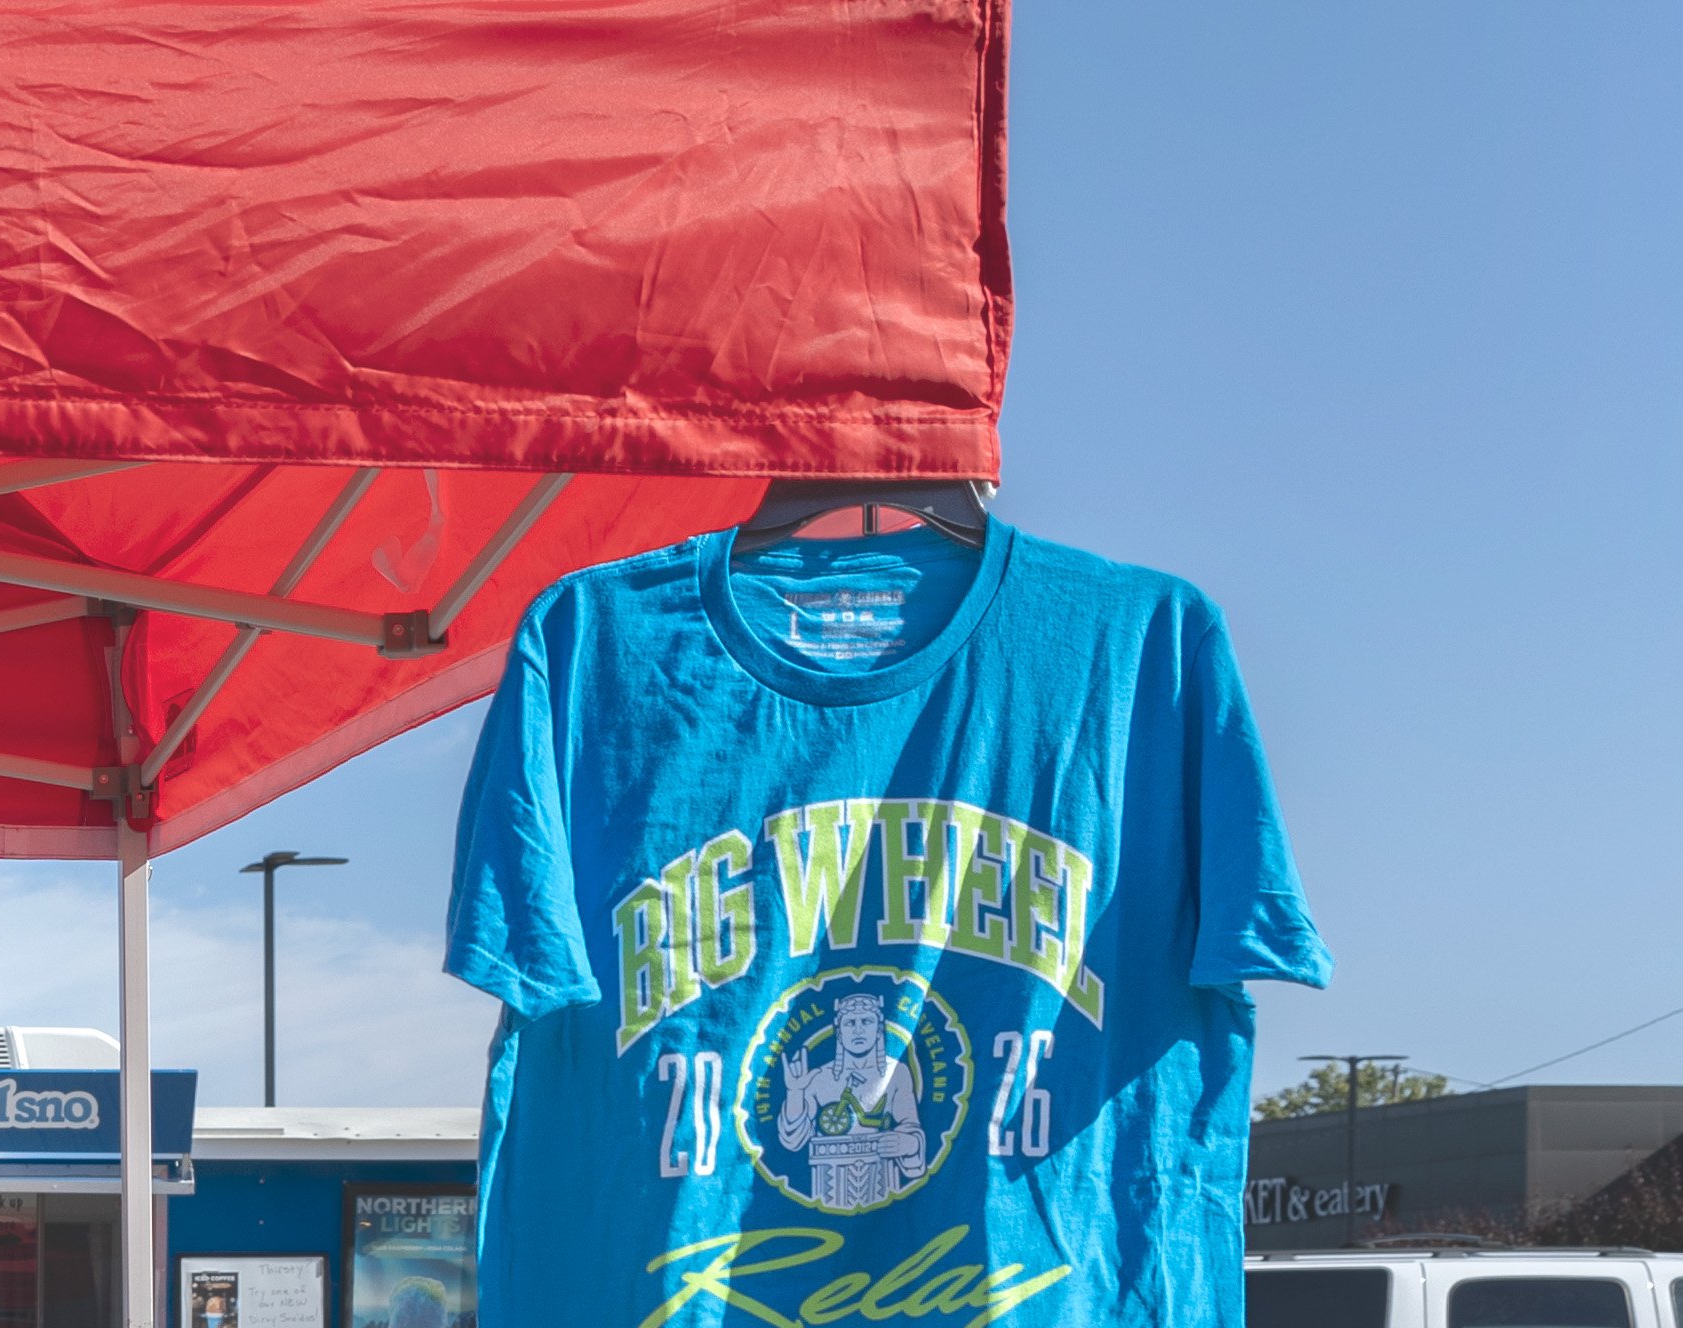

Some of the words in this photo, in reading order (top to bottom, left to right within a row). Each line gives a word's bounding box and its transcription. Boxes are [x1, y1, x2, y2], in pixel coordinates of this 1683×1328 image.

[614, 829, 757, 1059] BIG
[763, 798, 1106, 1031] WHEEL
[766, 1003, 825, 1068] ANNUAL
[896, 996, 948, 1104] CLEVELAND
[15, 1096, 100, 1124] sno
[658, 1051, 724, 1178] 20
[988, 1029, 1054, 1158] 26
[10, 1196, 23, 1212] up
[381, 1216, 460, 1233] LIGHTS
[1244, 1177, 1286, 1225] KET
[1287, 1185, 1310, 1222] &
[1314, 1180, 1390, 1221] eatery
